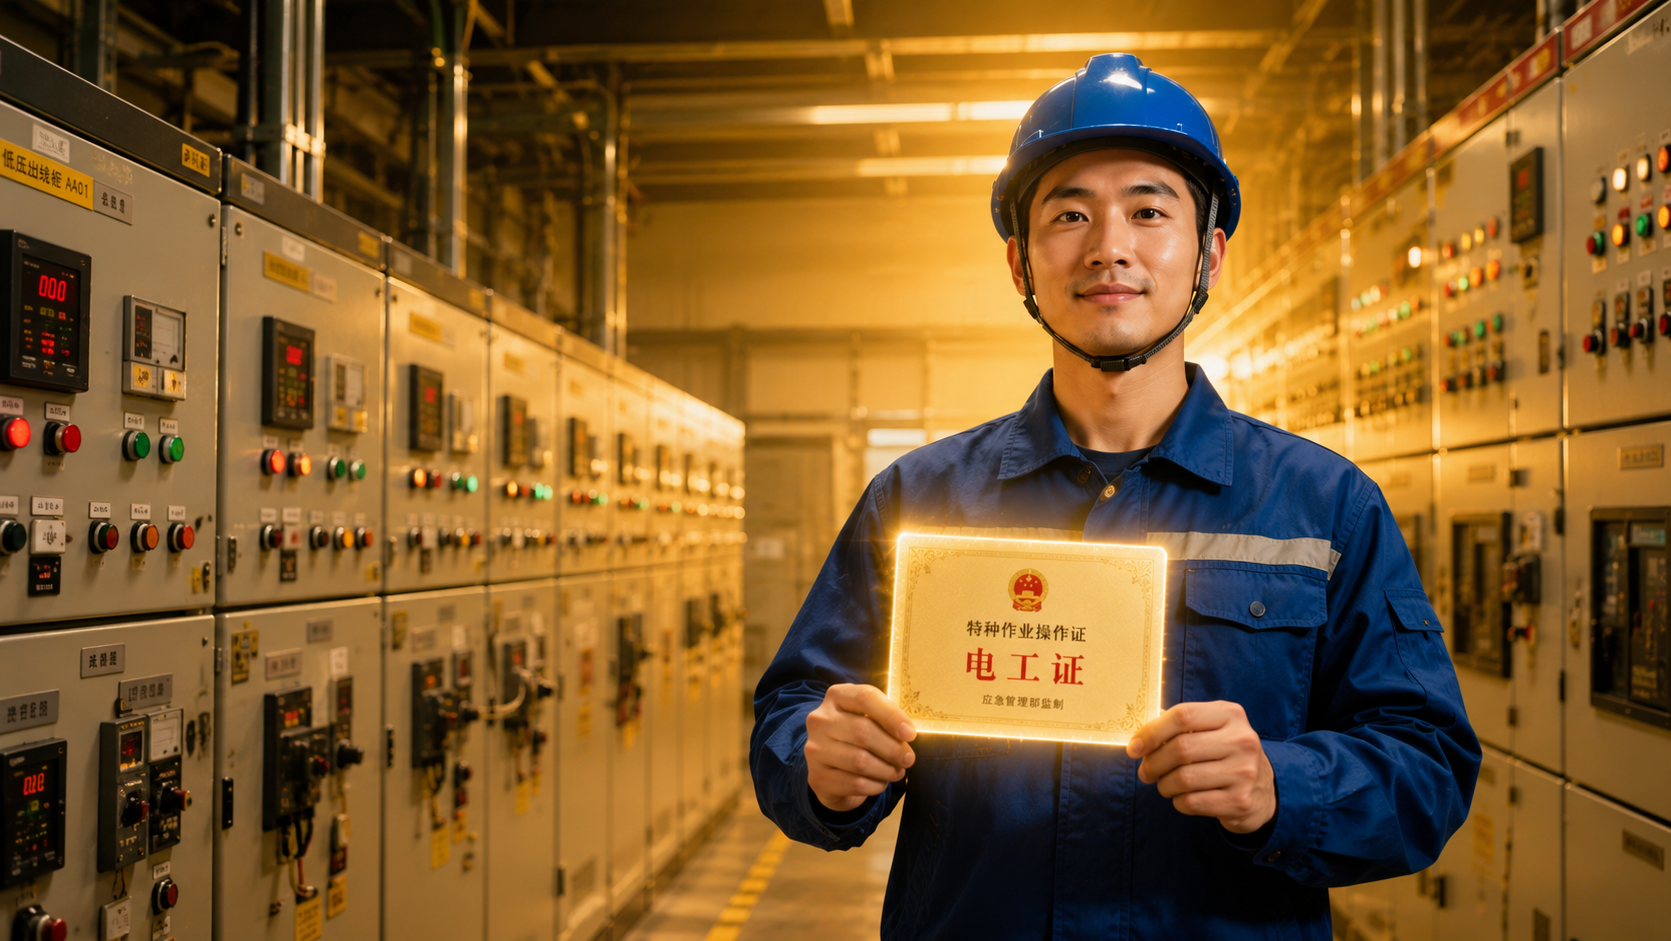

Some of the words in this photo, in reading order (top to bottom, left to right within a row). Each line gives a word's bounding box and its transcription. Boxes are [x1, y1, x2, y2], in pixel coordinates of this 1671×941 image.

[65, 176, 88, 198] AA01
[38, 274, 67, 302] 000
[966, 619, 1087, 642] 特种作业操作证
[966, 647, 1085, 686] 电工证
